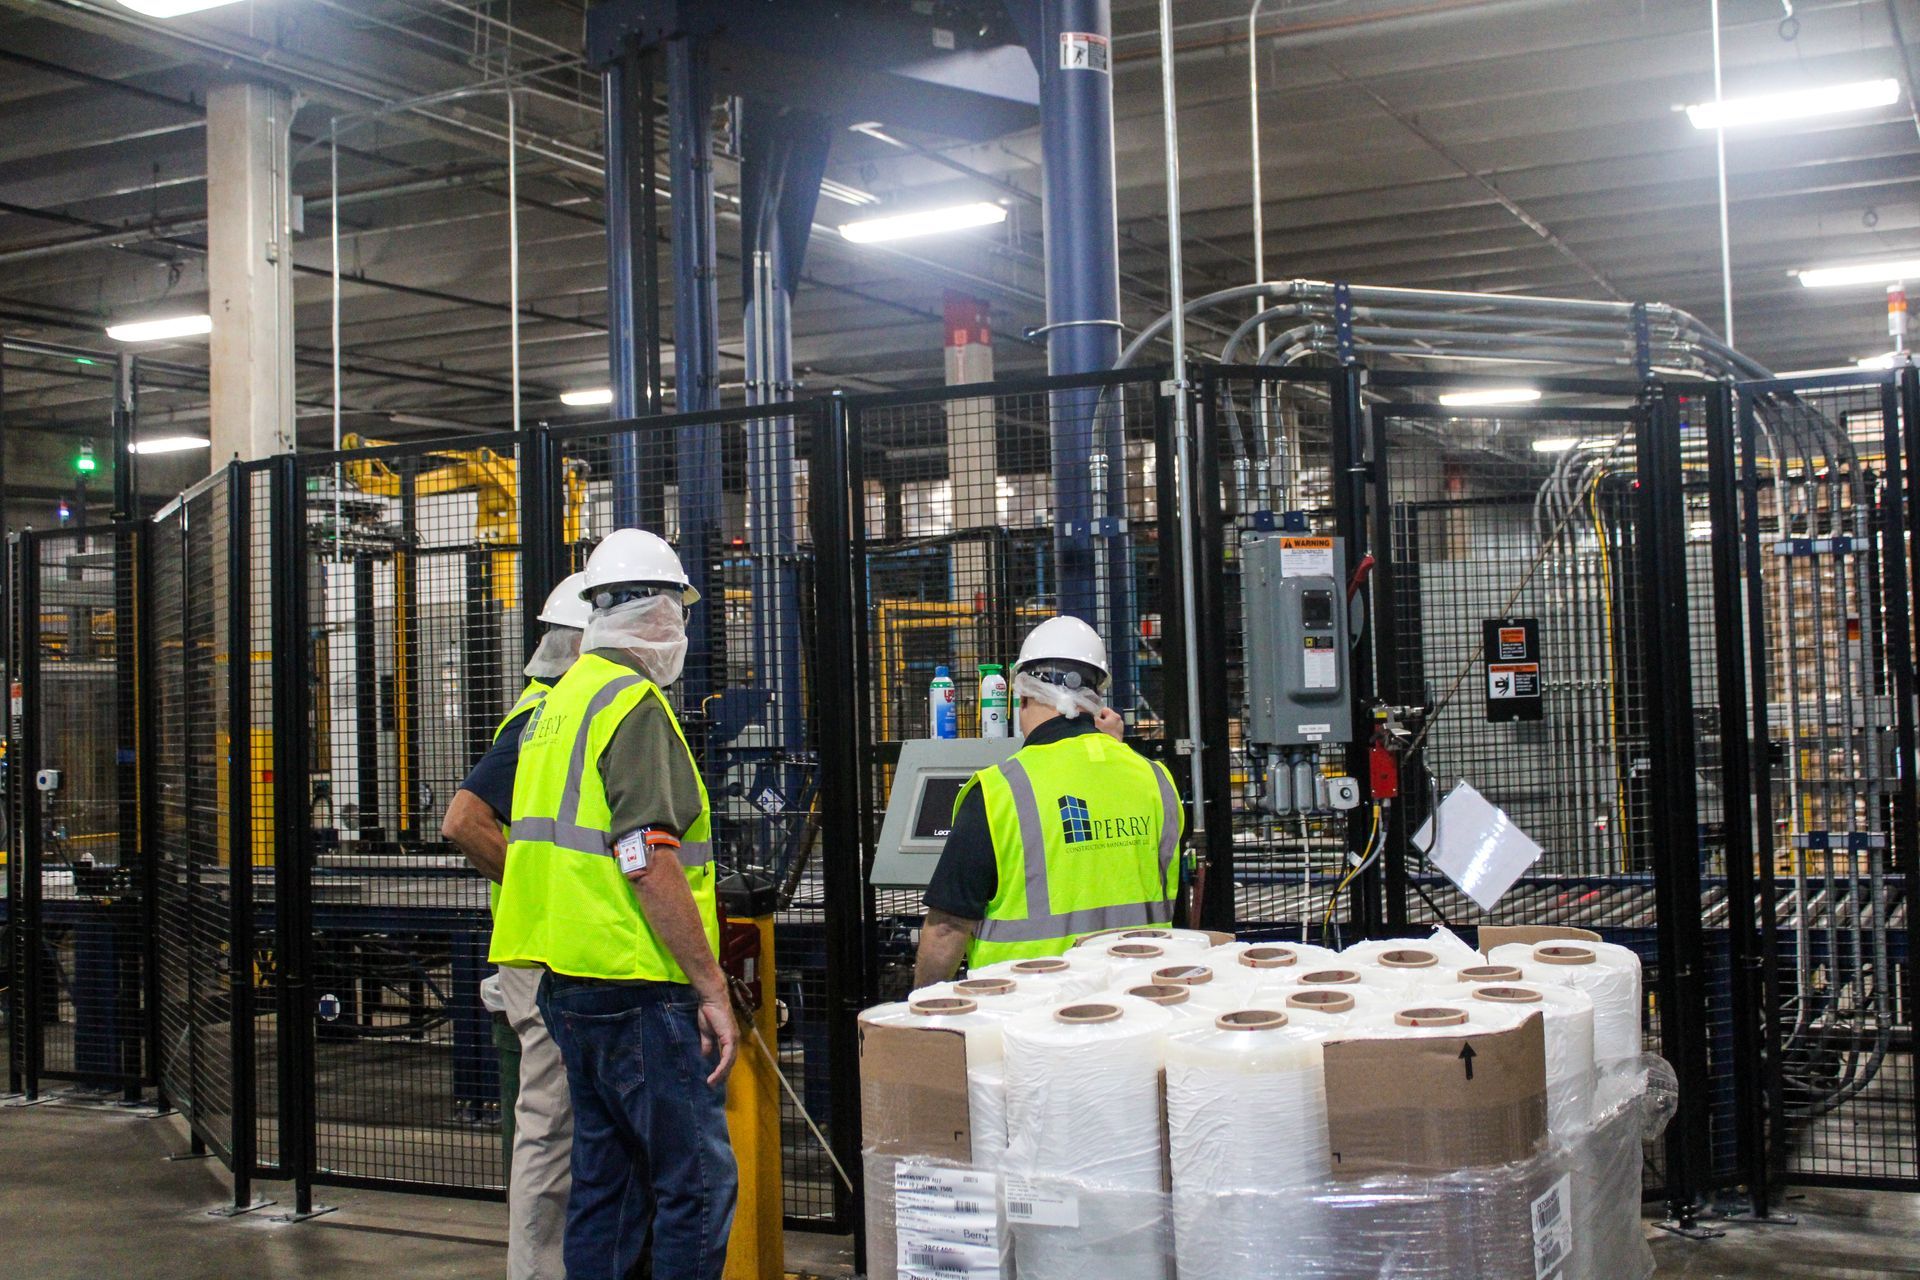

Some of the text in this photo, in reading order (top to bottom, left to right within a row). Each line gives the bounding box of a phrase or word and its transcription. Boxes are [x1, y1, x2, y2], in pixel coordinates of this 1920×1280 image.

[1294, 539, 1330, 547] WARNING
[1093, 815, 1150, 840] PERRY
[1065, 843, 1106, 854] CONSTRUCTION
[963, 1228, 989, 1243] Berry
